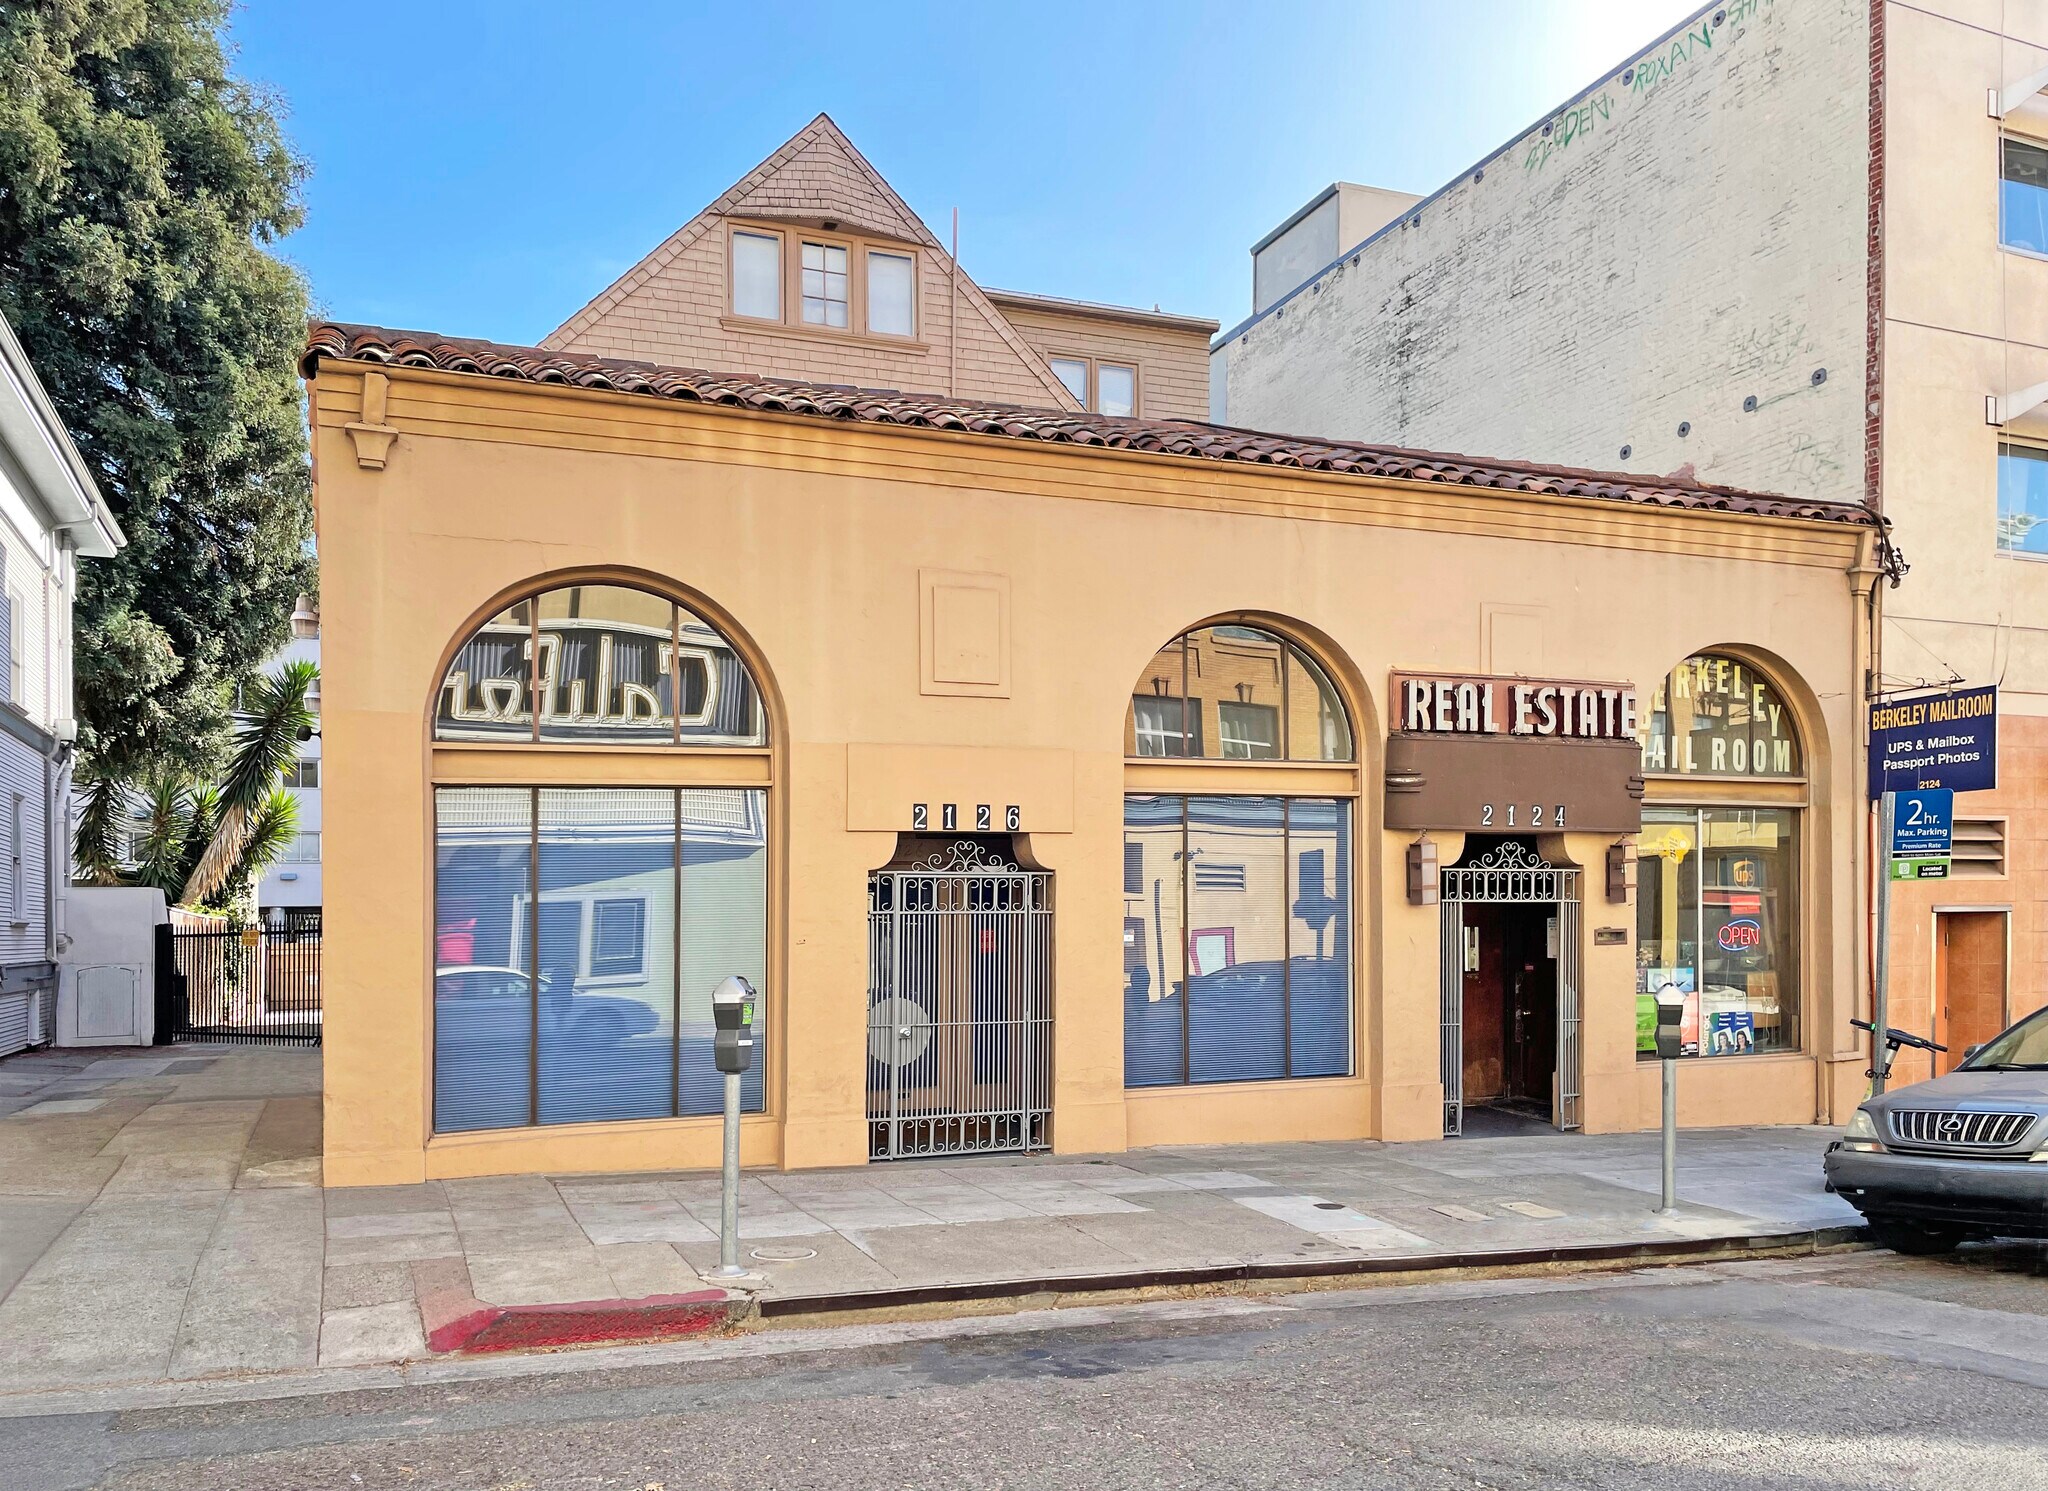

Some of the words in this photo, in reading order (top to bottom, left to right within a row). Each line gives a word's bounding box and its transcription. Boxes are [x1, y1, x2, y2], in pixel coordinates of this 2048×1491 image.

[1403, 680, 1500, 731] REAL
[1509, 685, 1637, 738] ESTATE
[1873, 704, 1927, 731] BERKELEY
[1929, 694, 1993, 723] MAILROOM
[1711, 737, 1791, 772] ROOM
[1888, 741, 1913, 754] UPS
[1915, 739, 1925, 750] &
[1927, 735, 1975, 749] Mailbox
[1883, 755, 1935, 771] Passport
[1937, 751, 1980, 765] Photos
[1919, 779, 1941, 789] 2124
[913, 806, 1019, 830] 2126
[1482, 805, 1566, 828] 2124
[1906, 799, 1923, 826] 2
[1924, 811, 1940, 825] hr.
[1897, 829, 1916, 837] Max.
[1917, 828, 1948, 837] Parking
[1718, 926, 1760, 945] OPEN
